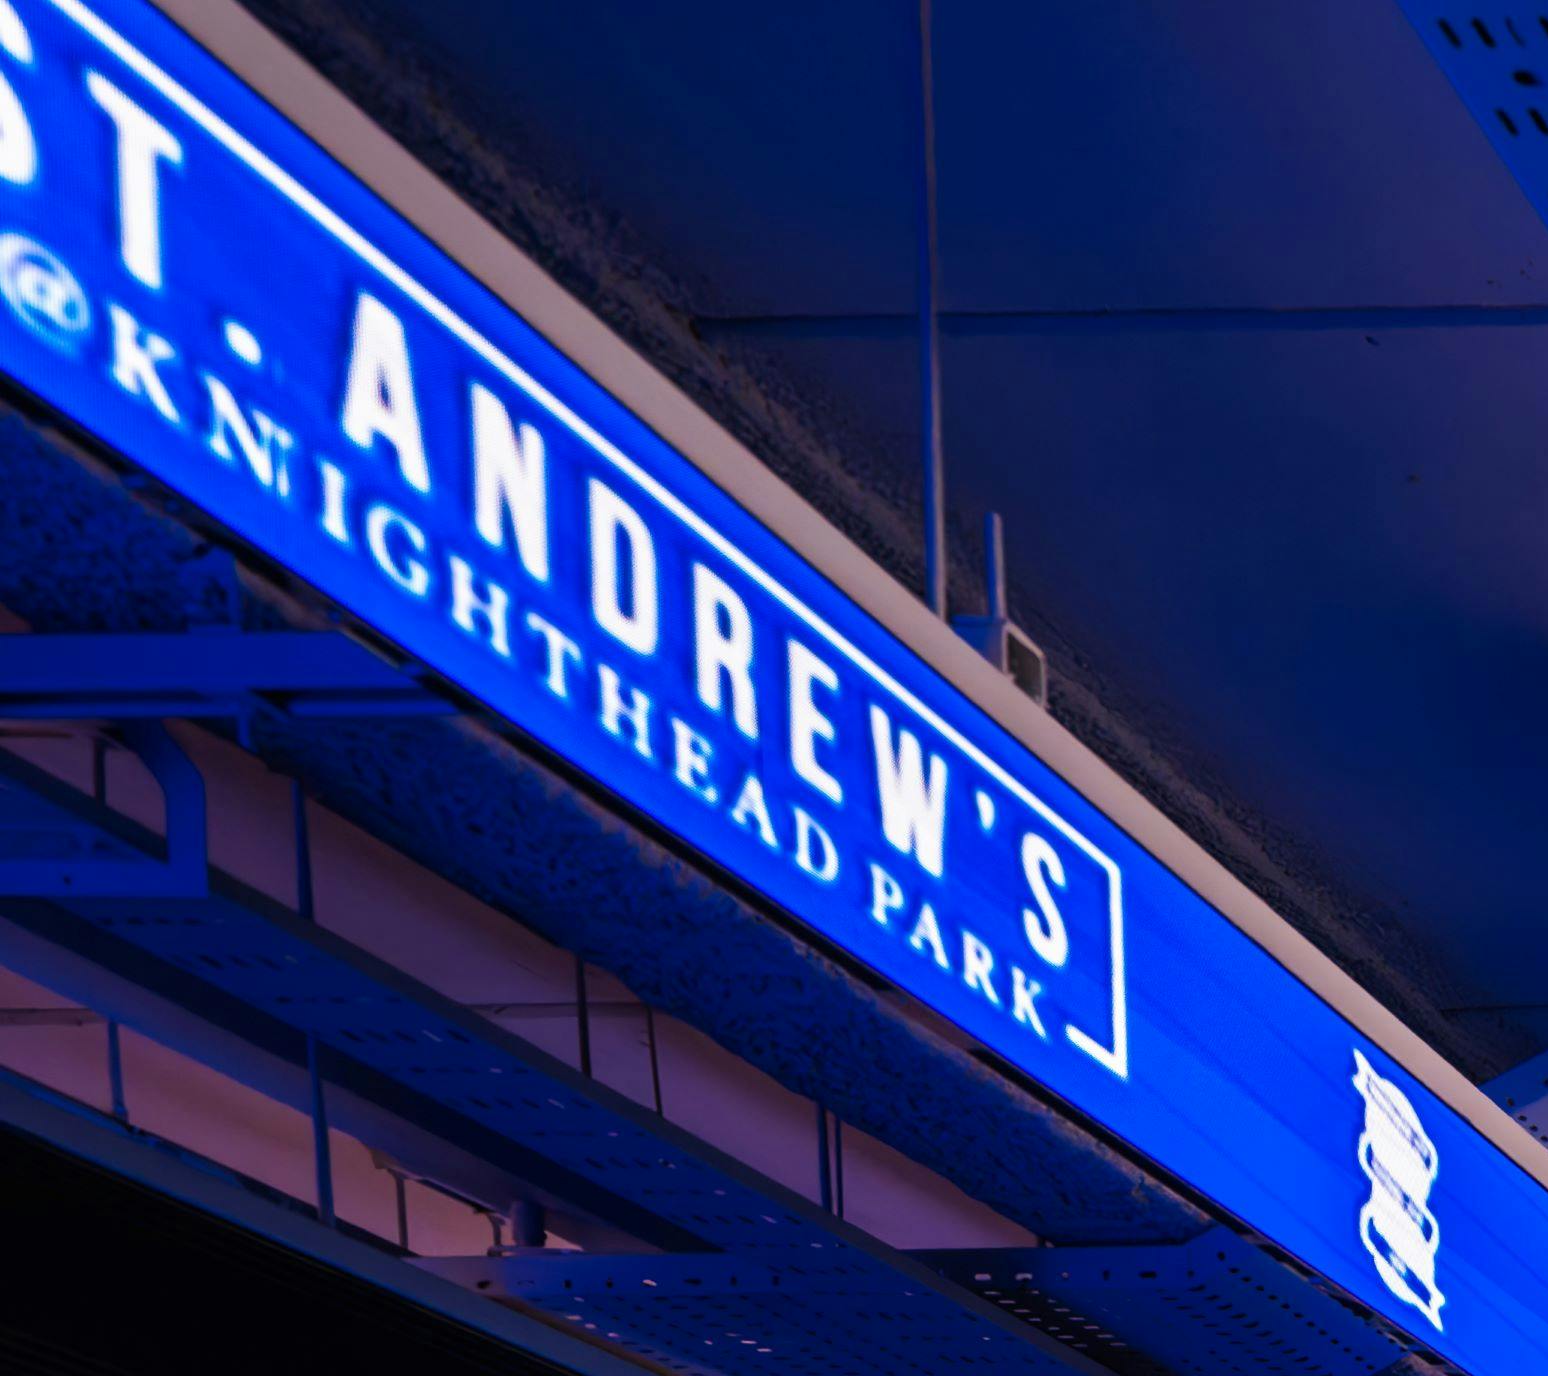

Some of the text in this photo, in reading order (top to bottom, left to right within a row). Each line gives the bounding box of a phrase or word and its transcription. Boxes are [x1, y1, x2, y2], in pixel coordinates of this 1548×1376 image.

[0, 232, 1046, 1040] @KNIGHTHEAD PARK
[341, 288, 1069, 967] ANDREW'S
